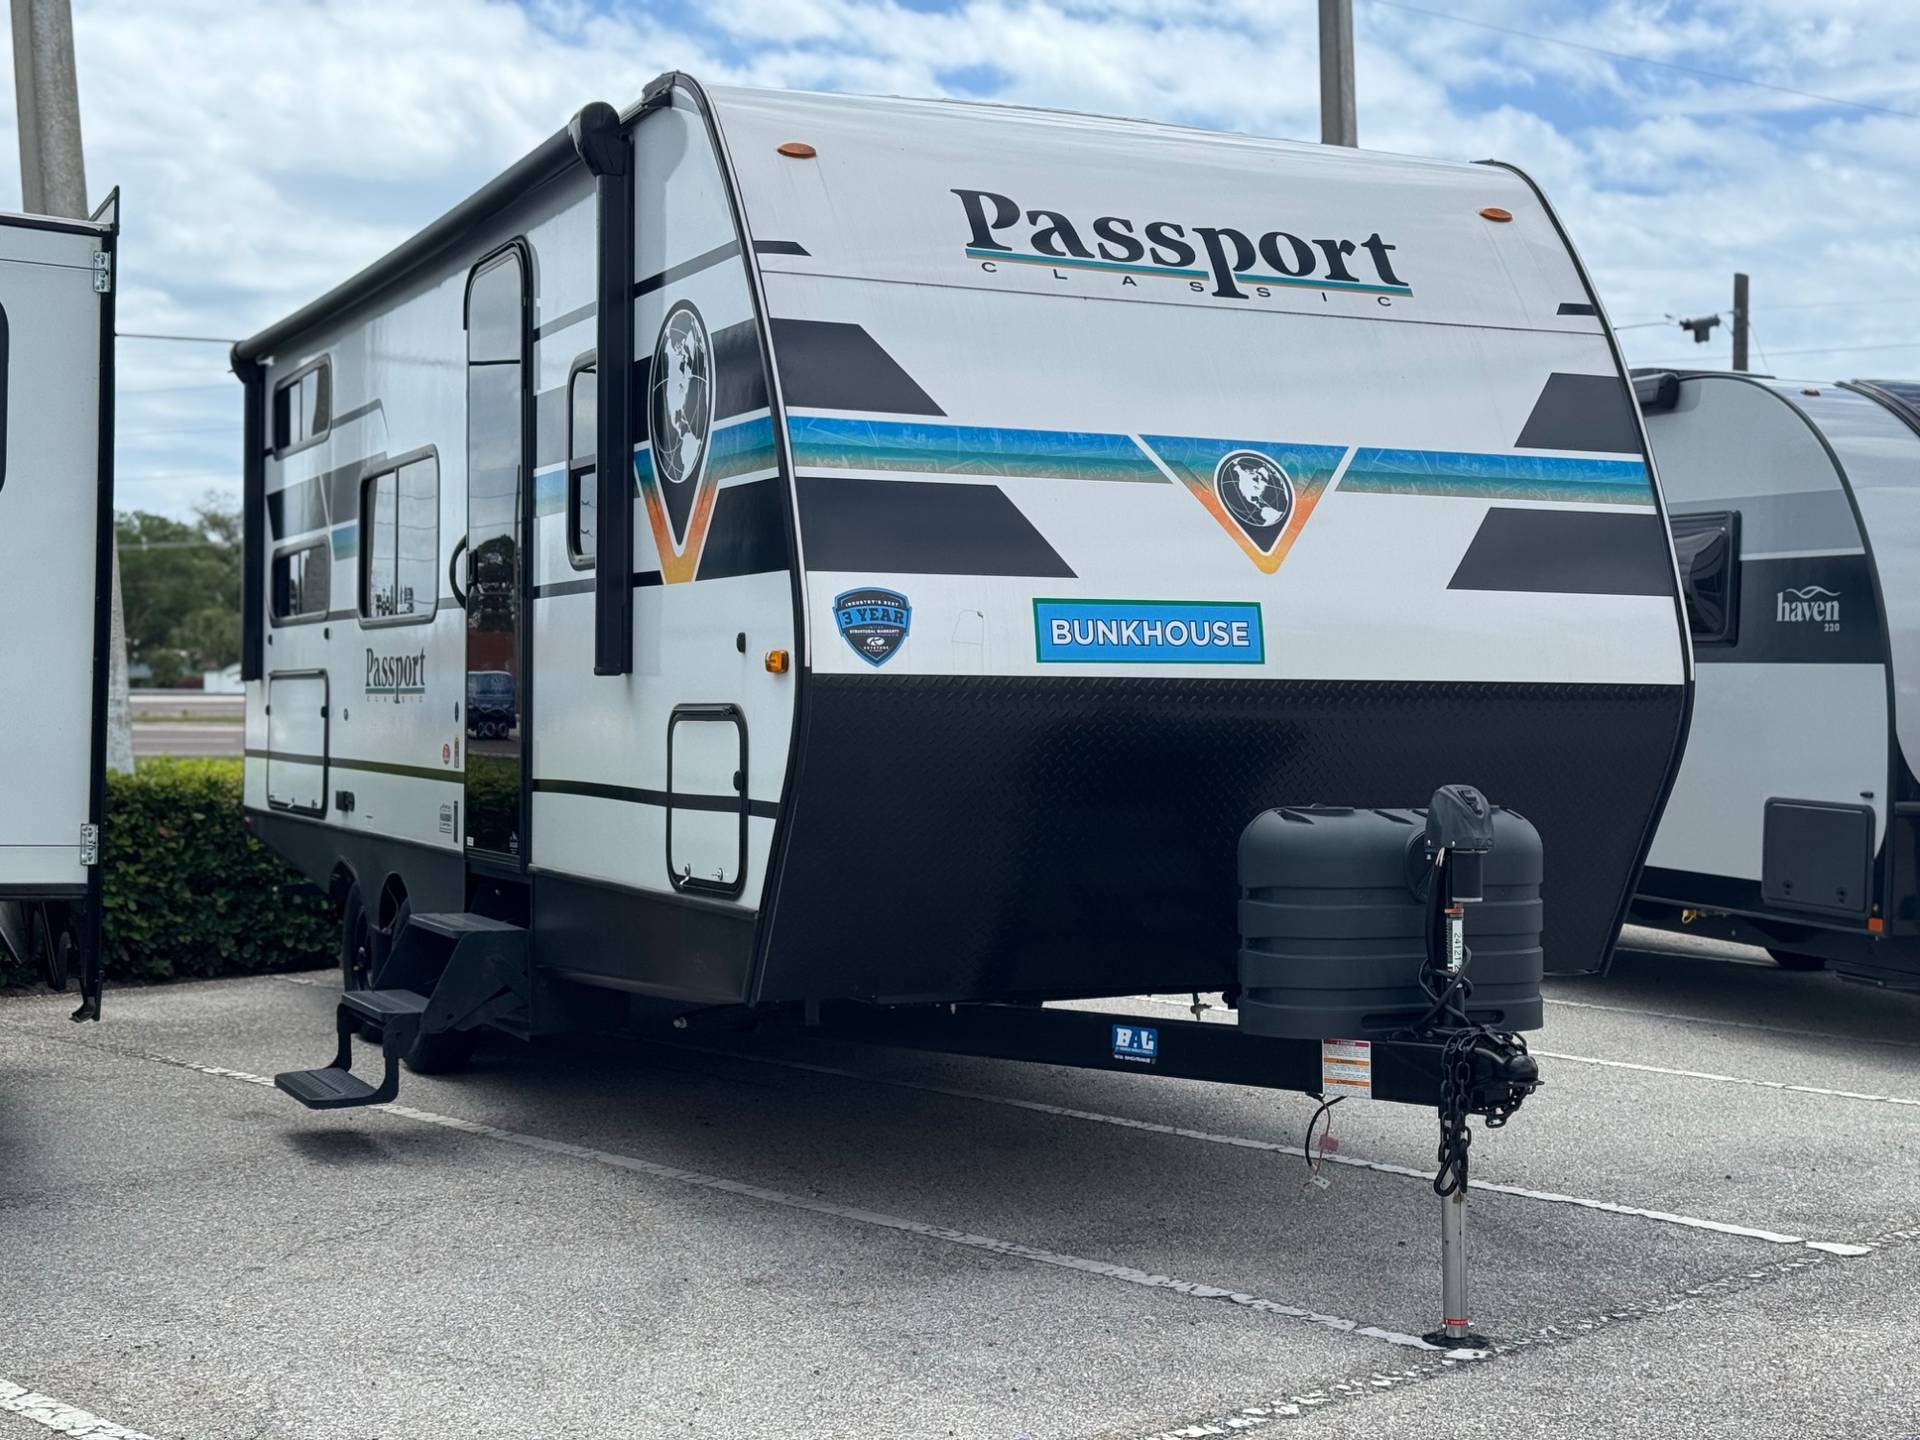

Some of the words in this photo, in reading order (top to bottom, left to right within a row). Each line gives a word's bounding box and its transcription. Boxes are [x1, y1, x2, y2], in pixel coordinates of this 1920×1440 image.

[950, 188, 1409, 300] Passport
[980, 261, 1393, 307] CLASSIC
[842, 611, 853, 625] 3
[857, 607, 904, 625] YEAR
[1776, 592, 1840, 622] haven
[1051, 618, 1250, 647] BUNKHOUSE
[1823, 623, 1840, 632] 220
[366, 647, 425, 704] Passport
[1116, 1027, 1155, 1050] BAL
